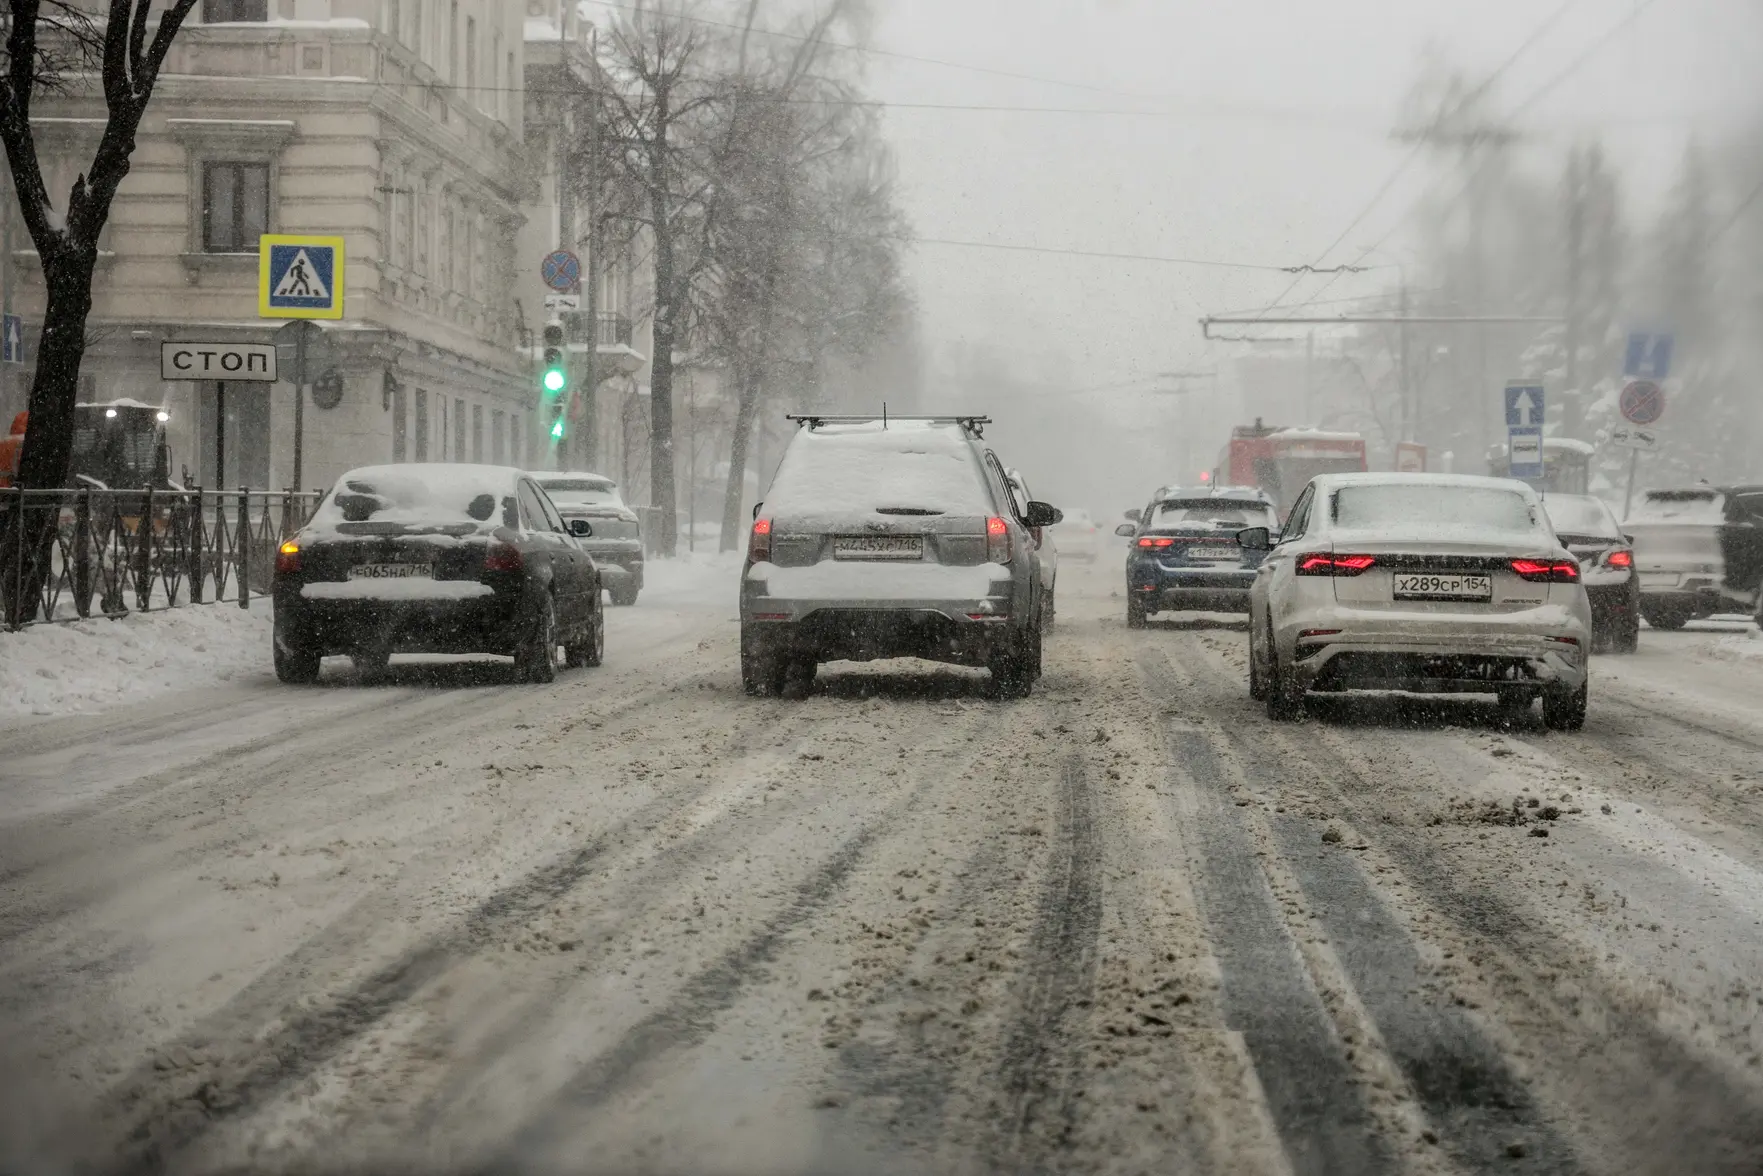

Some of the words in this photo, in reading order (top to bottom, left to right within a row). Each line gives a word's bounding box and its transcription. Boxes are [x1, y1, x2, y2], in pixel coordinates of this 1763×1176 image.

[172, 350, 267, 373] СТОП
[1399, 576, 1460, 592] Х289СР
[1463, 577, 1488, 591] 154
